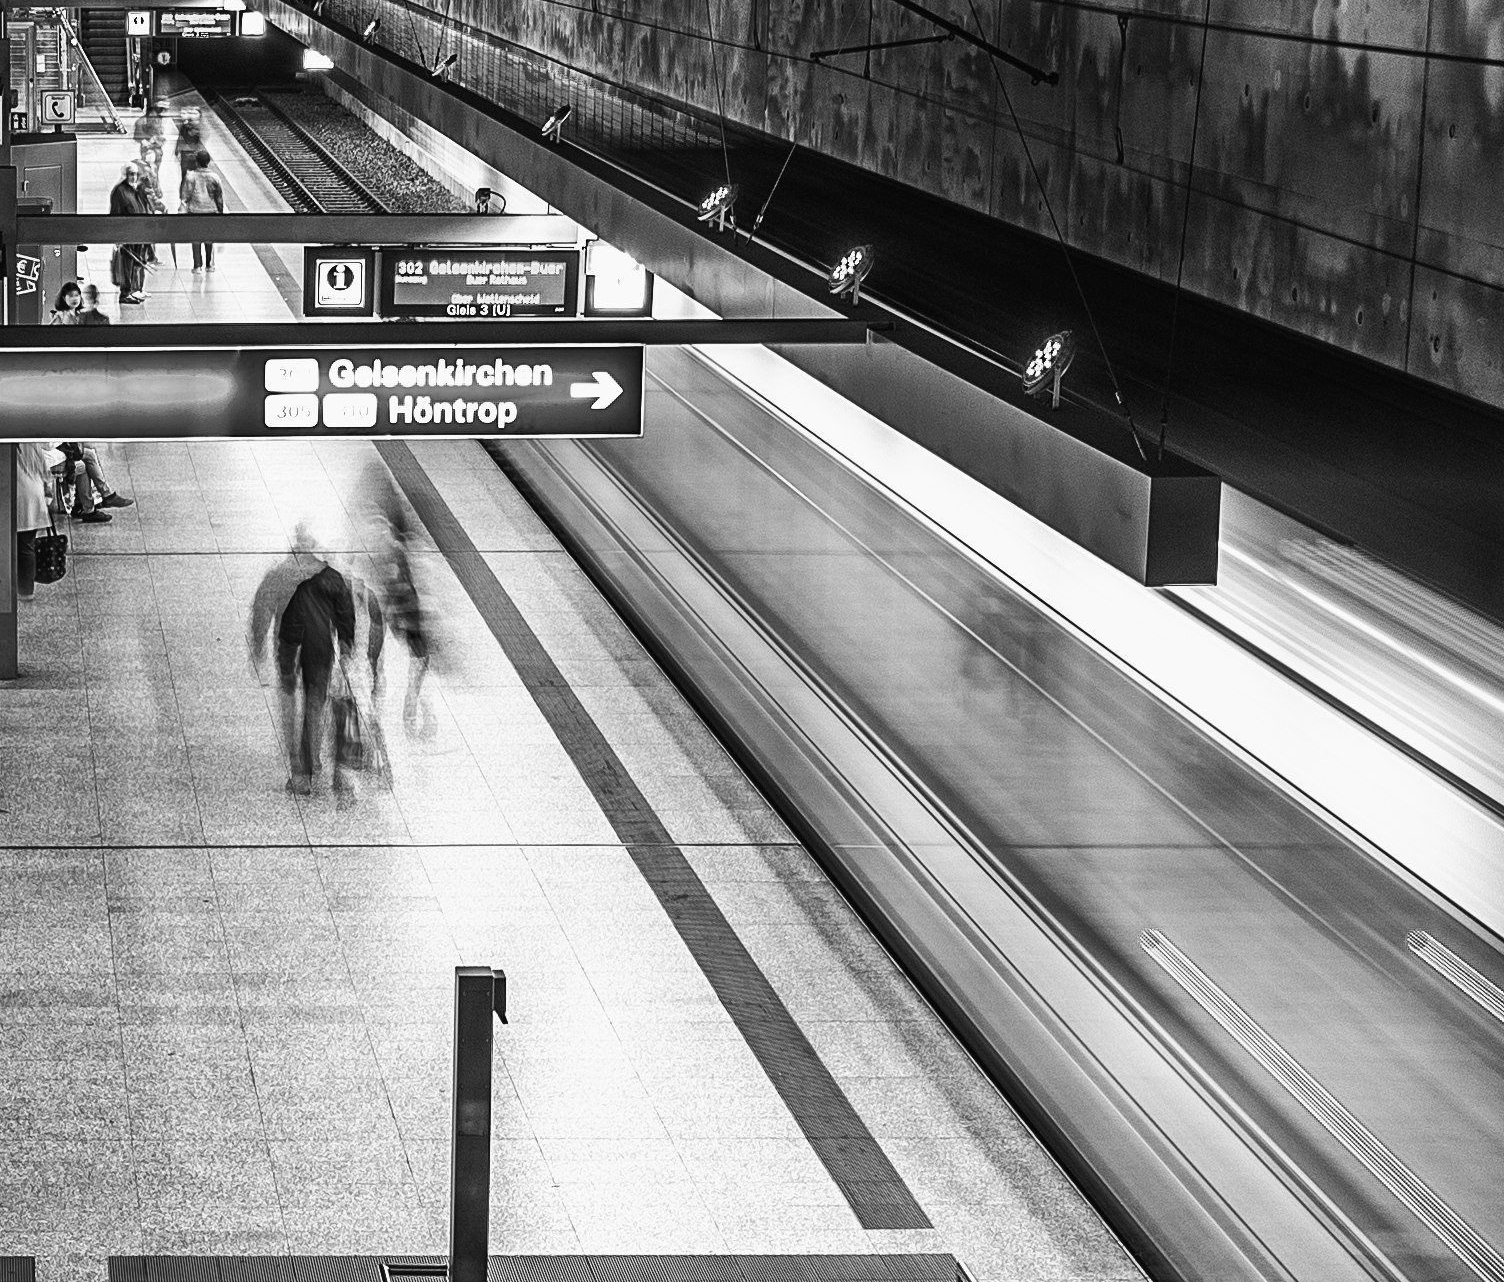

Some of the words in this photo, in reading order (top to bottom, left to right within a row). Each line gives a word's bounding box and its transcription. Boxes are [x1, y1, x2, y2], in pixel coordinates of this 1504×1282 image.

[398, 262, 423, 275] 302
[447, 304, 476, 316] Gleis
[480, 305, 489, 316] 3
[328, 358, 553, 388] Gelsenkirchen
[389, 395, 518, 429] Höntrop
